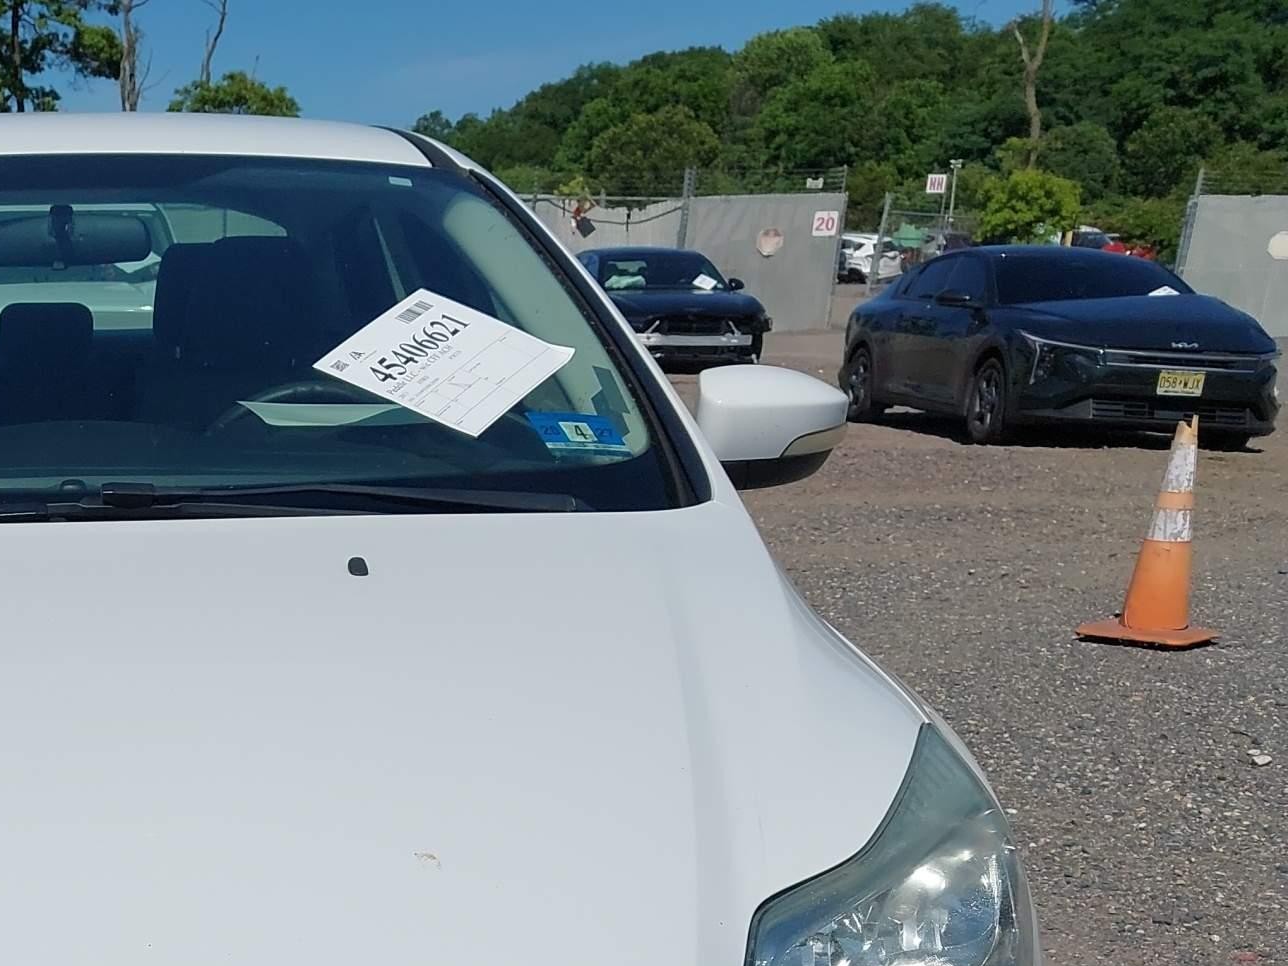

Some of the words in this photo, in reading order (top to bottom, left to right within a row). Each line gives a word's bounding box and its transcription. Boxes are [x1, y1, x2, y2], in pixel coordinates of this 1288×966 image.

[814, 217, 835, 231] 20
[369, 313, 471, 383] 45406621
[573, 424, 589, 440] 4
